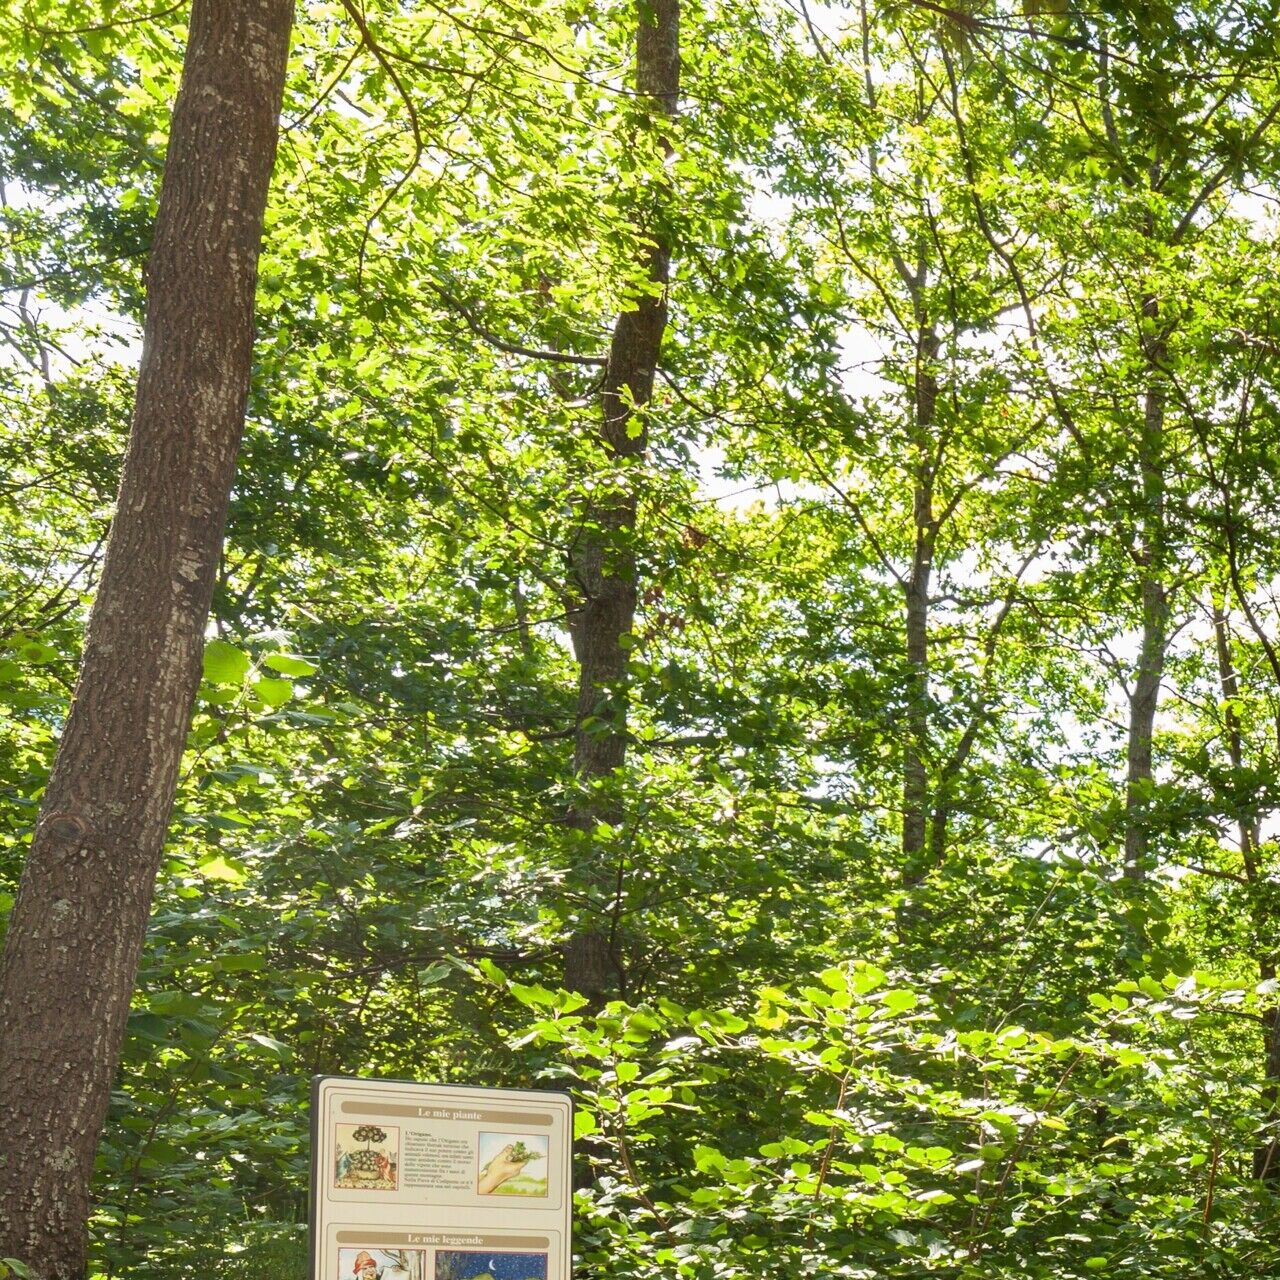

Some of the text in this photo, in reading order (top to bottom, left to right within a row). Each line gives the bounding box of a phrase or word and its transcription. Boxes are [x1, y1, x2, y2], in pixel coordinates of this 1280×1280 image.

[417, 1108, 482, 1120] Le mie piante
[408, 1234, 484, 1246] Le mie leggende
